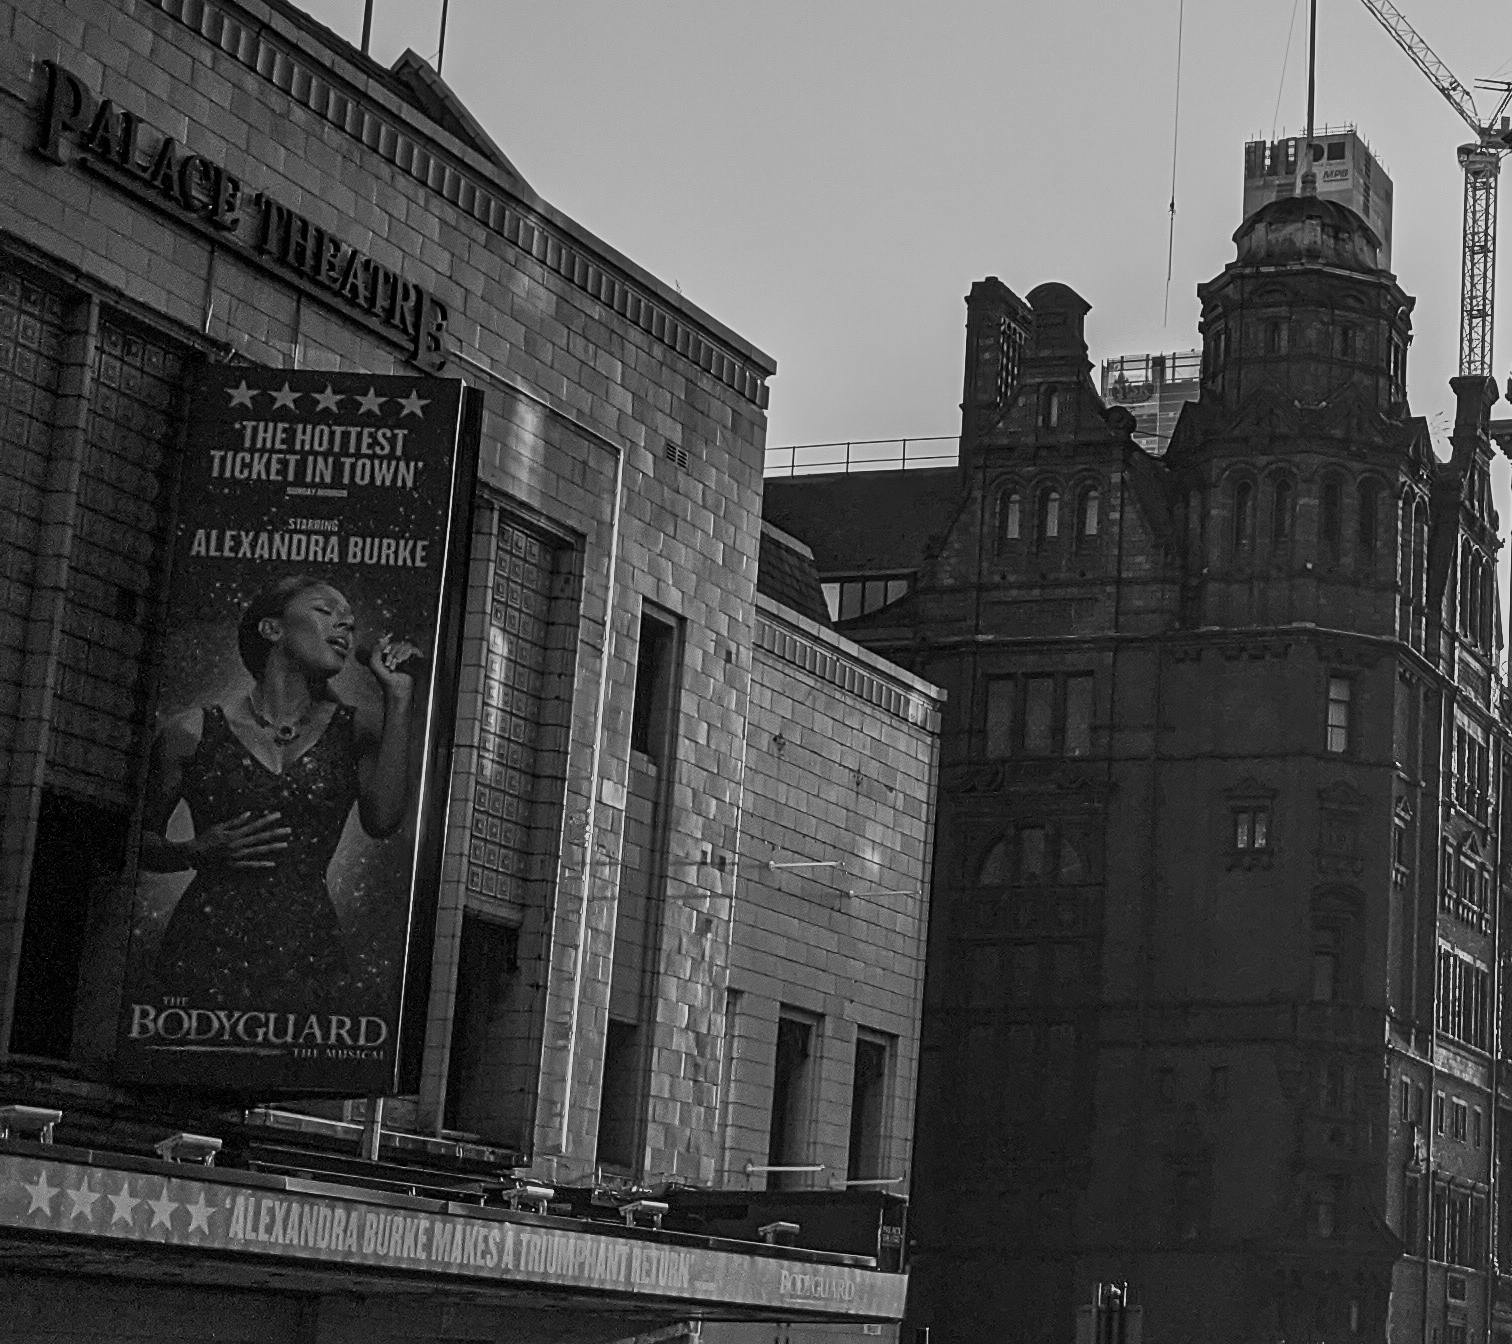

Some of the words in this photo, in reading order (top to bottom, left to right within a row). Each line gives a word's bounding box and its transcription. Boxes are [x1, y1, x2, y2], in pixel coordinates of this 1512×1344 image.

[32, 59, 241, 233] PALACE
[254, 190, 449, 373] THEATRE
[294, 423, 409, 456] HOTTEST
[210, 450, 301, 482] TICKET
[305, 455, 335, 484] IN
[190, 529, 341, 563] ALEXANDRA
[347, 536, 430, 568] BURKE
[128, 1003, 388, 1046] BODYGUARD
[362, 1211, 430, 1260] BURKE
[431, 1220, 501, 1269] MAKES
[501, 1228, 515, 1271] A
[519, 1232, 631, 1282] TRIUMPHANT
